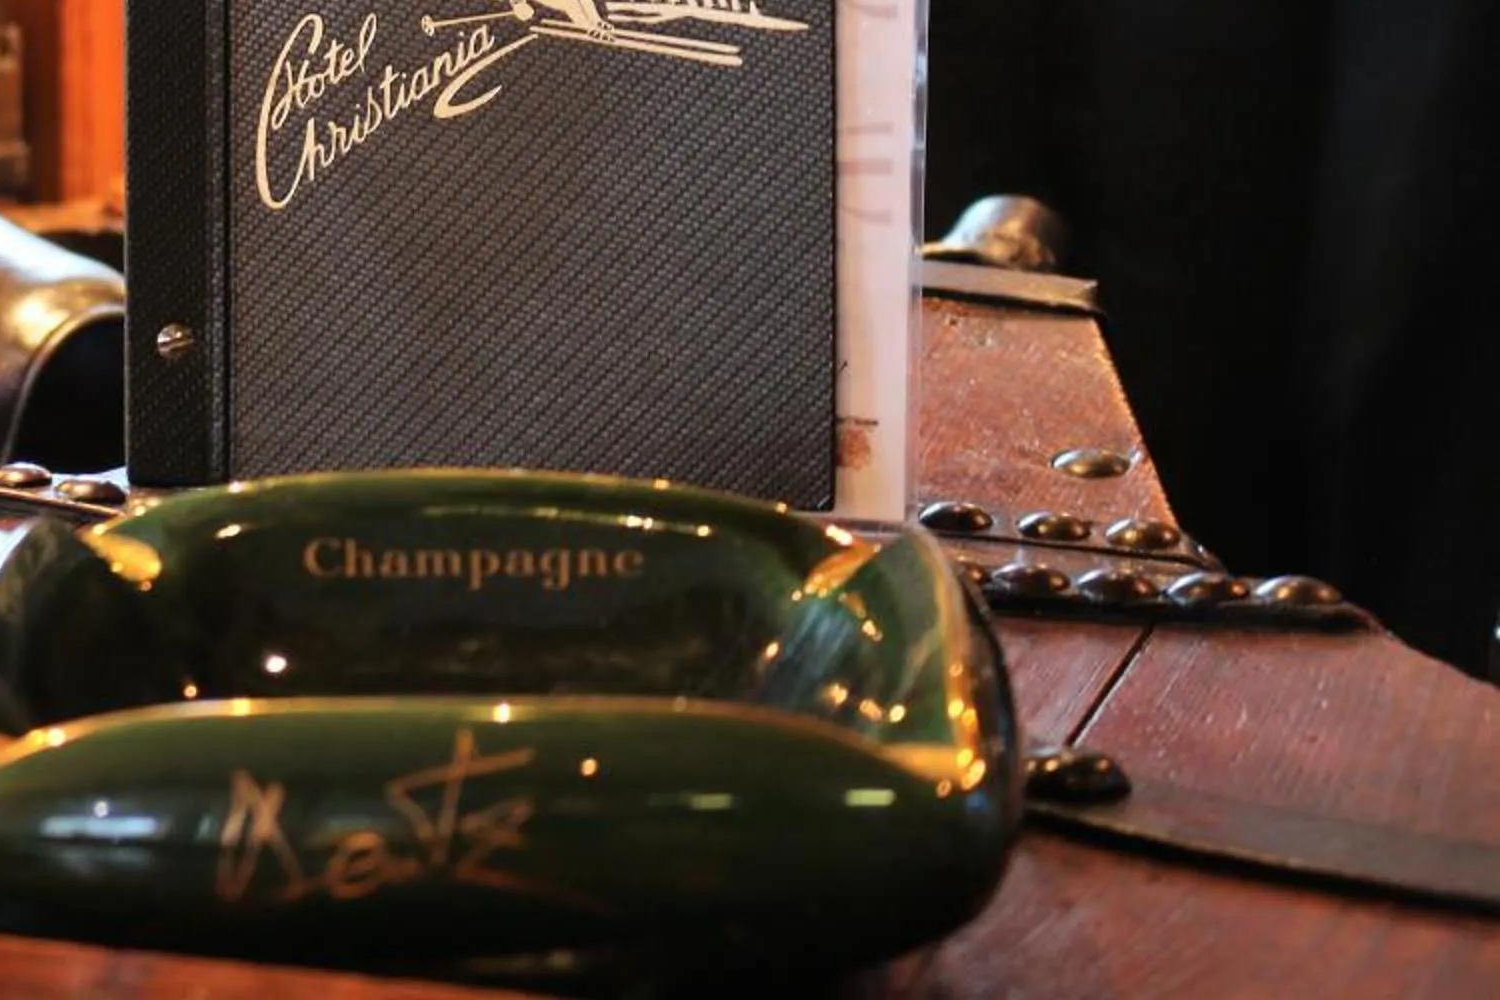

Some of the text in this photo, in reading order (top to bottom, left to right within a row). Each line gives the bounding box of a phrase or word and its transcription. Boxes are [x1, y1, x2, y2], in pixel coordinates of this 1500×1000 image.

[256, 13, 496, 209] Christiania
[271, 13, 377, 130] Hotel
[303, 536, 645, 590] Champagne
